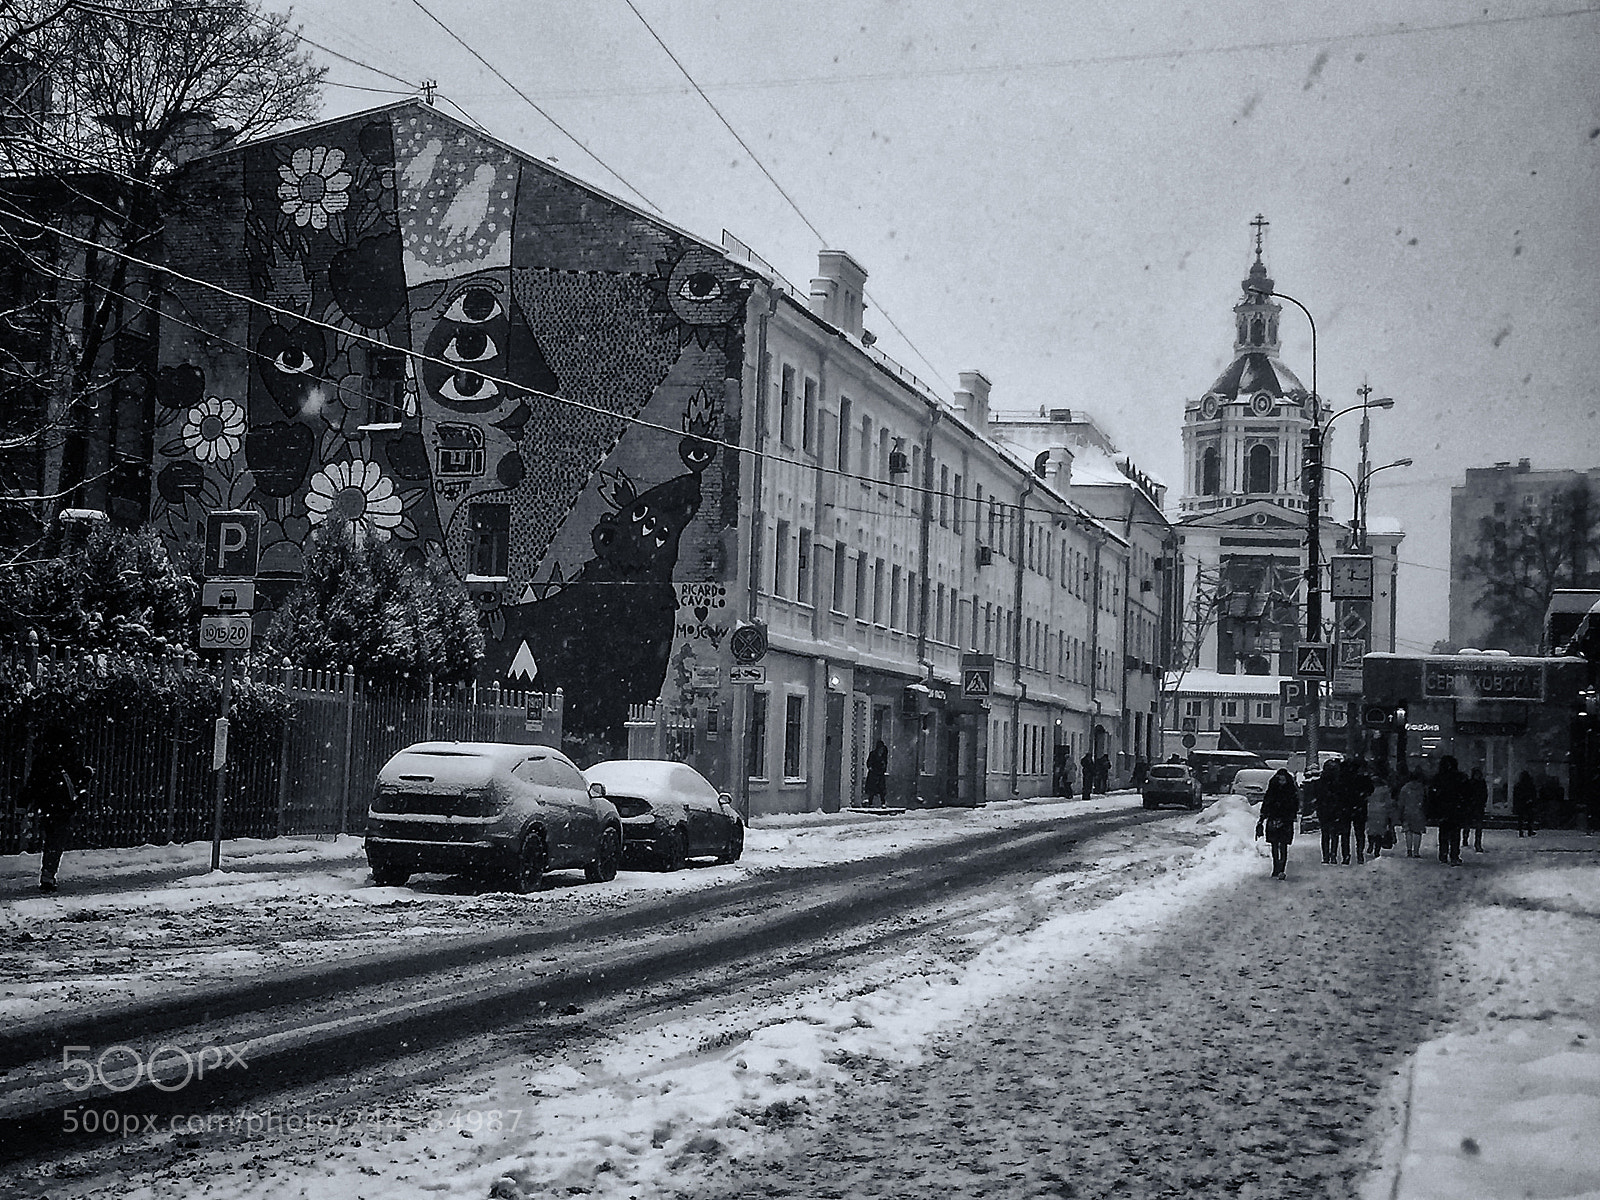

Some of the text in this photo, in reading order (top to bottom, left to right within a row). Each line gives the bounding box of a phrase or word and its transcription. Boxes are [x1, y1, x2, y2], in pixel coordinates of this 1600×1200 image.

[218, 522, 247, 569] P
[681, 584, 726, 597] RICARDO
[680, 596, 726, 608] CAVOLO
[216, 627, 226, 638] 15
[230, 626, 246, 640] 20
[1426, 673, 1541, 692] СЕРХОВСКАЯ
[1286, 685, 1300, 704] P
